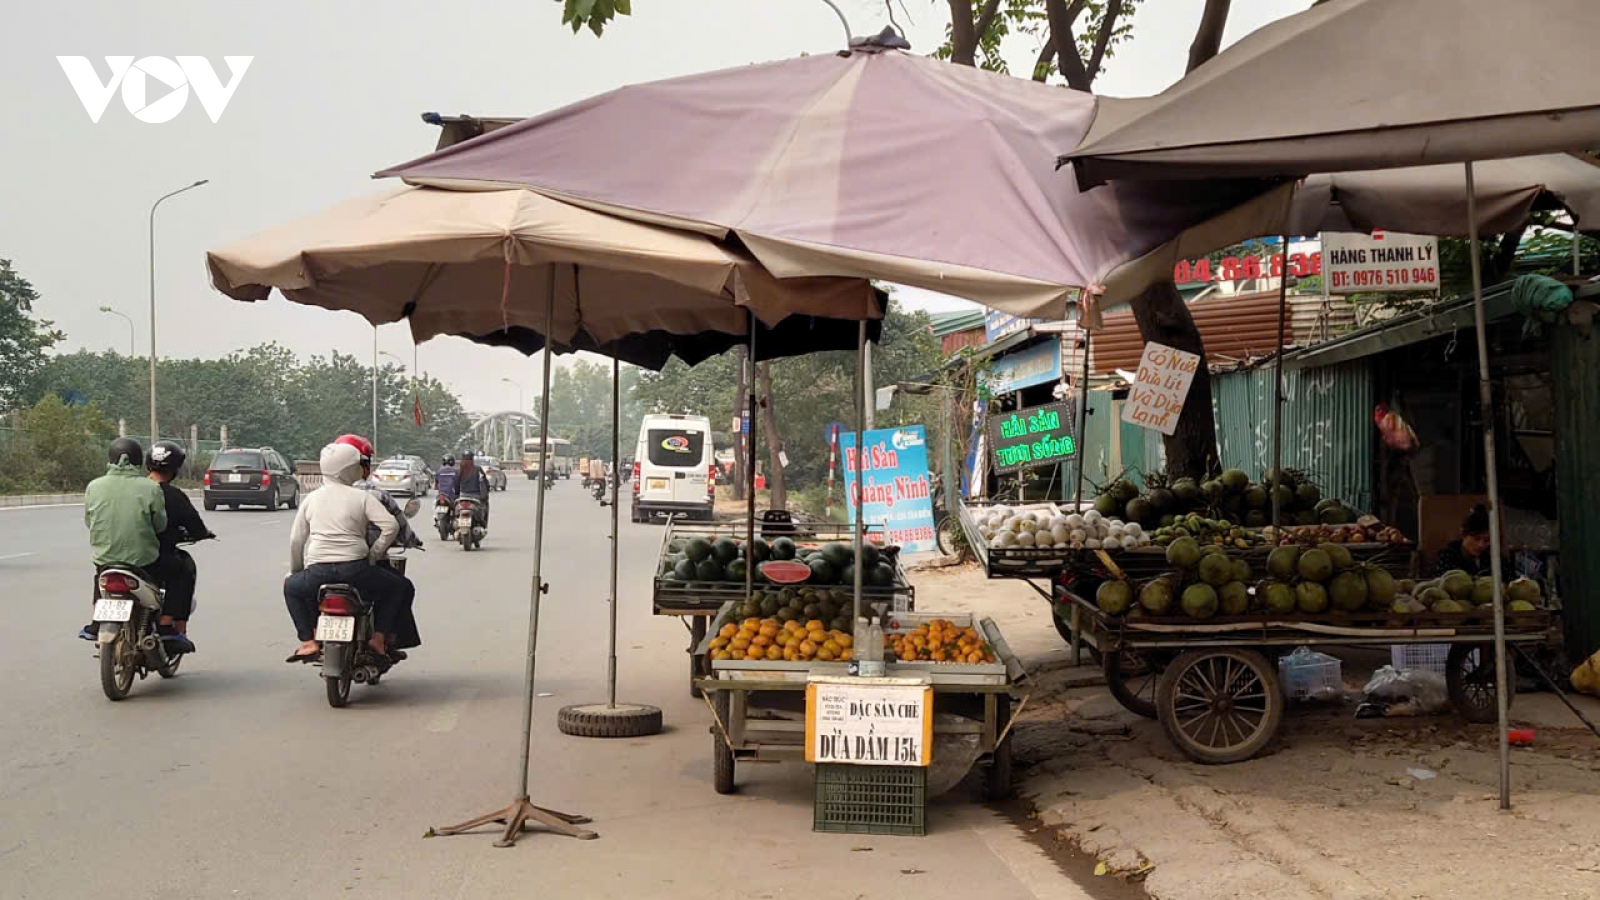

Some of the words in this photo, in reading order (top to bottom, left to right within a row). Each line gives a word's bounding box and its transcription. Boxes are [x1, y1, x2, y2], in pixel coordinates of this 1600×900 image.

[1370, 246, 1413, 265] THANH
[1418, 242, 1433, 262] LÝ
[1353, 269, 1383, 286] 0976
[1386, 268, 1409, 285] 510
[1412, 266, 1436, 283] 946
[1149, 349, 1168, 365] Có
[1001, 414, 1027, 439] HẢI
[1028, 408, 1060, 433] SẢN
[871, 441, 898, 470] Sản
[1032, 433, 1074, 458] SỐNG
[895, 474, 929, 501] Ninh
[323, 630, 348, 640] 1945
[850, 701, 872, 720] ĐẶC
[874, 699, 895, 717] SẢN
[898, 701, 920, 718] CHÈ
[820, 728, 850, 760] DỪA
[894, 738, 917, 762] 15k
